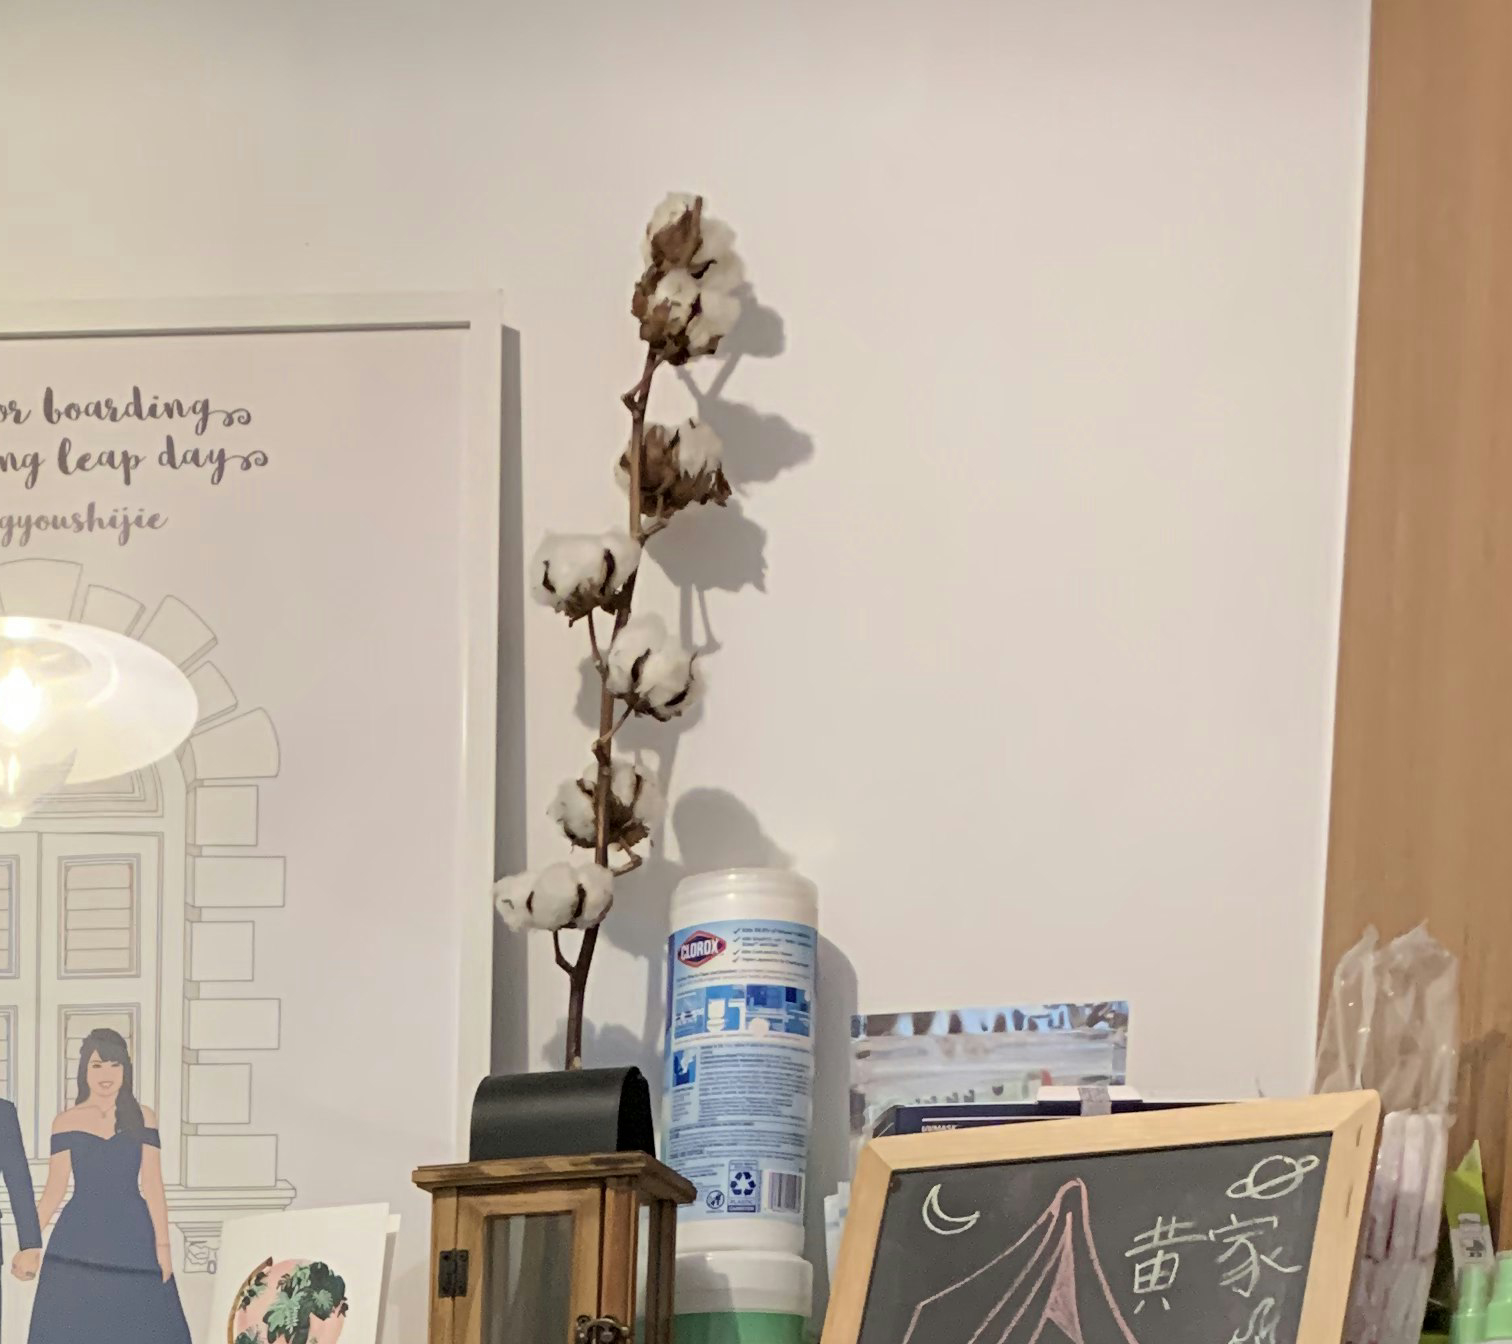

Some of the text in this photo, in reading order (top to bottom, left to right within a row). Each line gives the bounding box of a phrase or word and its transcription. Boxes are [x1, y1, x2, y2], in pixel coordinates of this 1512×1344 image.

[43, 385, 252, 436] boarding
[58, 437, 146, 486] leap
[157, 434, 269, 486] day
[680, 936, 720, 961] CLOROX
